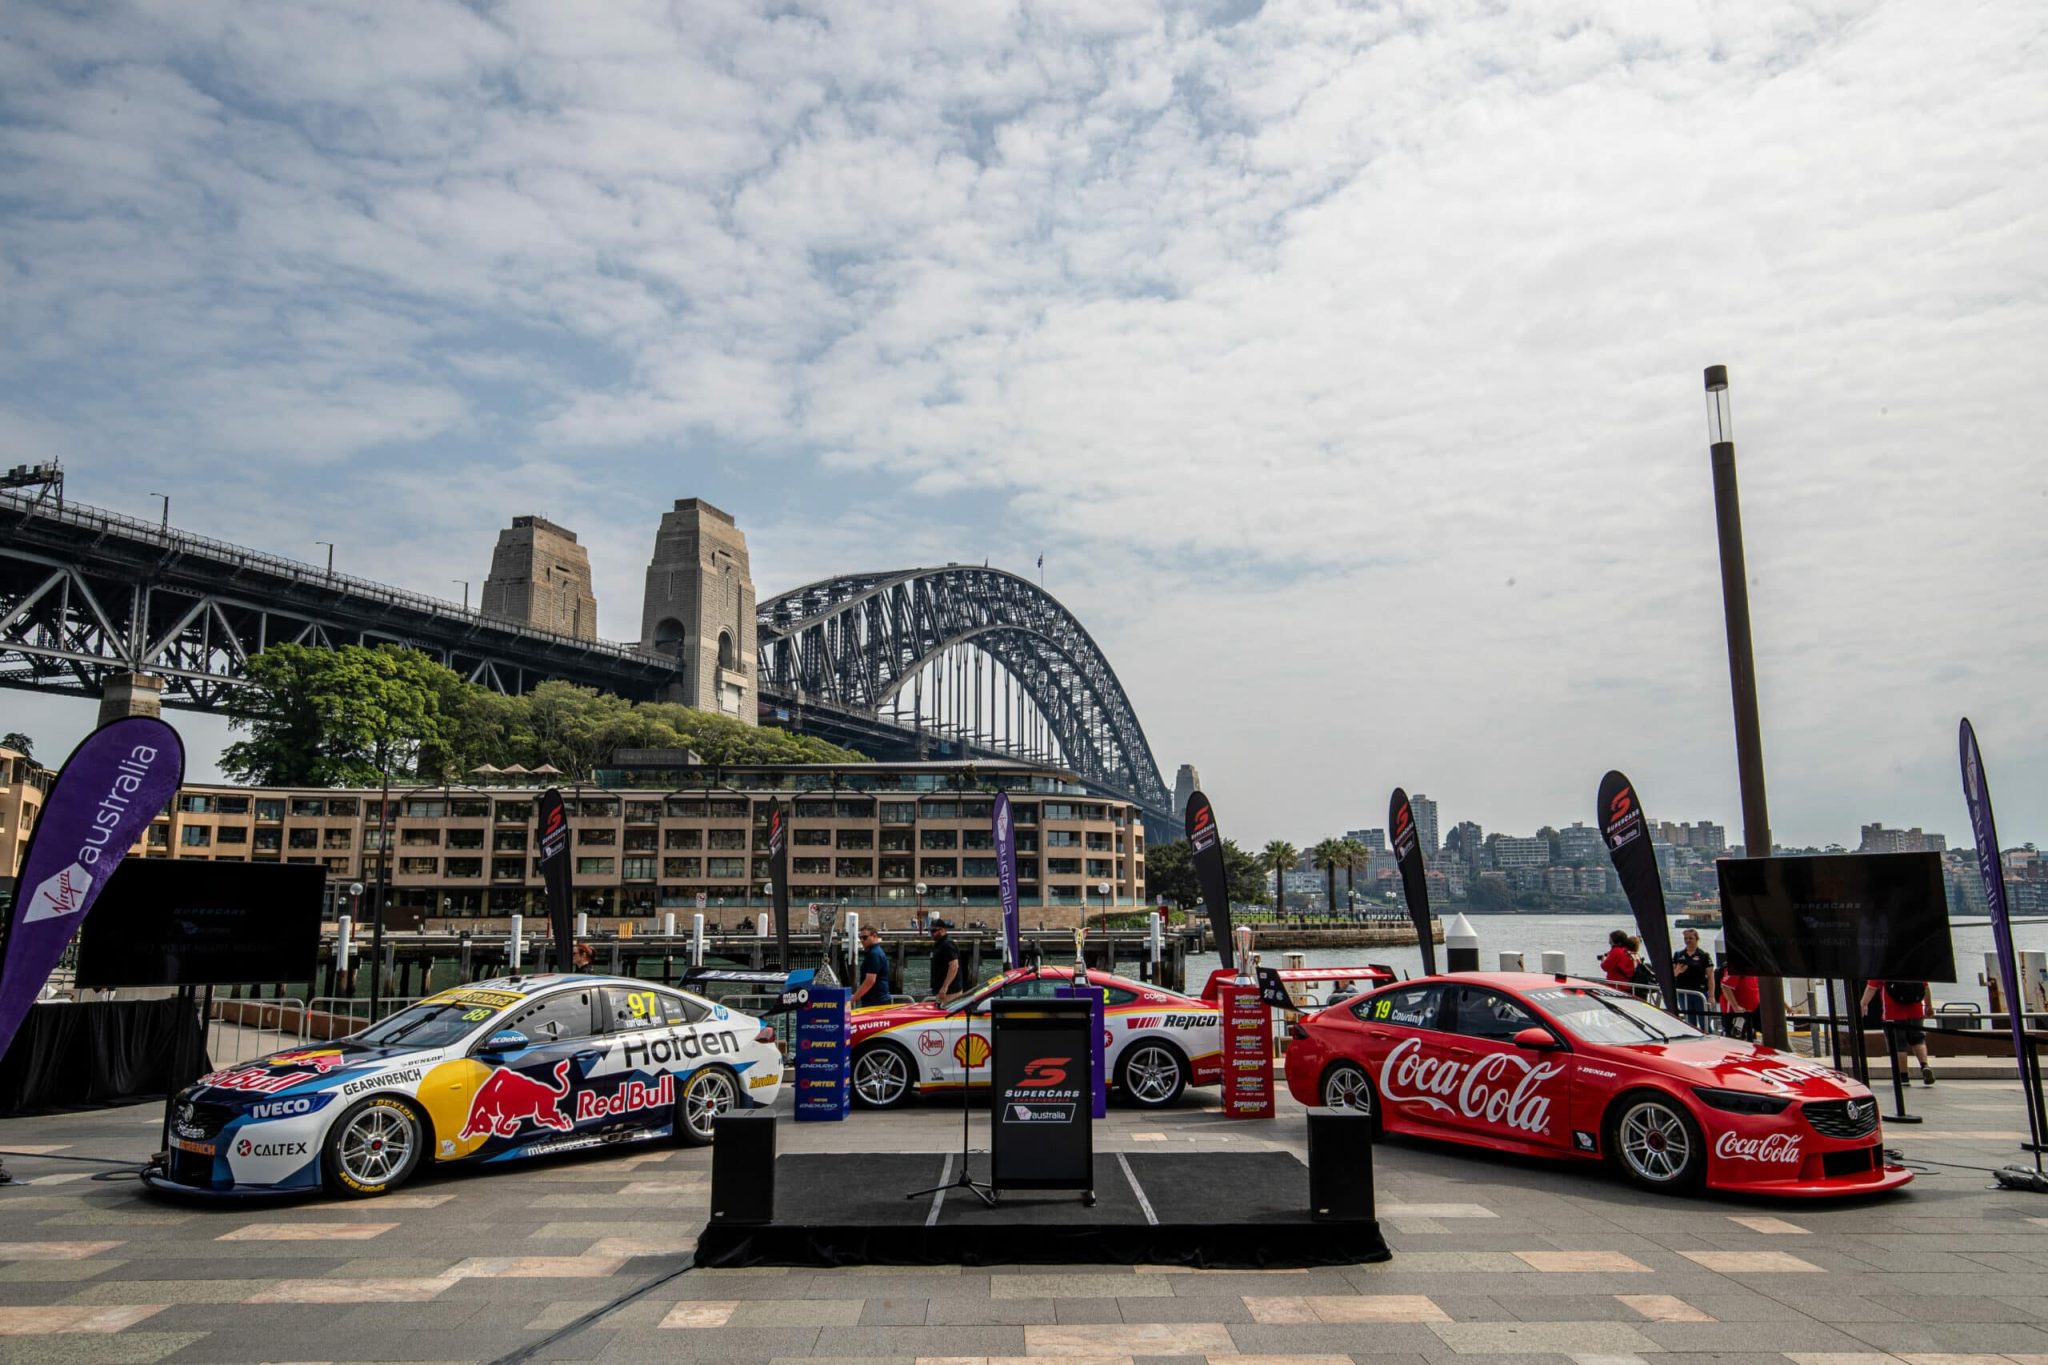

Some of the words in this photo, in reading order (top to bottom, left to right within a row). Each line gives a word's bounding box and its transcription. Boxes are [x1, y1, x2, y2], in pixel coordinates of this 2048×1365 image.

[43, 870, 82, 914] Virgin
[78, 745, 158, 864] australia
[1973, 805, 1999, 927] australia
[1000, 843, 1012, 915] australia
[627, 991, 656, 1017] 97
[1375, 1000, 1391, 1019] 19
[462, 1008, 491, 1021] 88
[1163, 1014, 1218, 1030] Repco
[622, 1026, 740, 1068] Holden
[407, 1055, 443, 1066] DUNLOP
[1582, 1066, 1616, 1078] DUNLOP
[342, 1068, 422, 1096] GEARWRENCH
[576, 1082, 627, 1121] Red
[627, 1074, 675, 1111] Bull
[1005, 1089, 1080, 1098] SUPERCARS
[252, 1099, 310, 1119] IVECO
[1031, 1110, 1066, 1119] australia
[253, 1142, 308, 1157] CALTEX
[528, 1143, 556, 1157] mtaa
